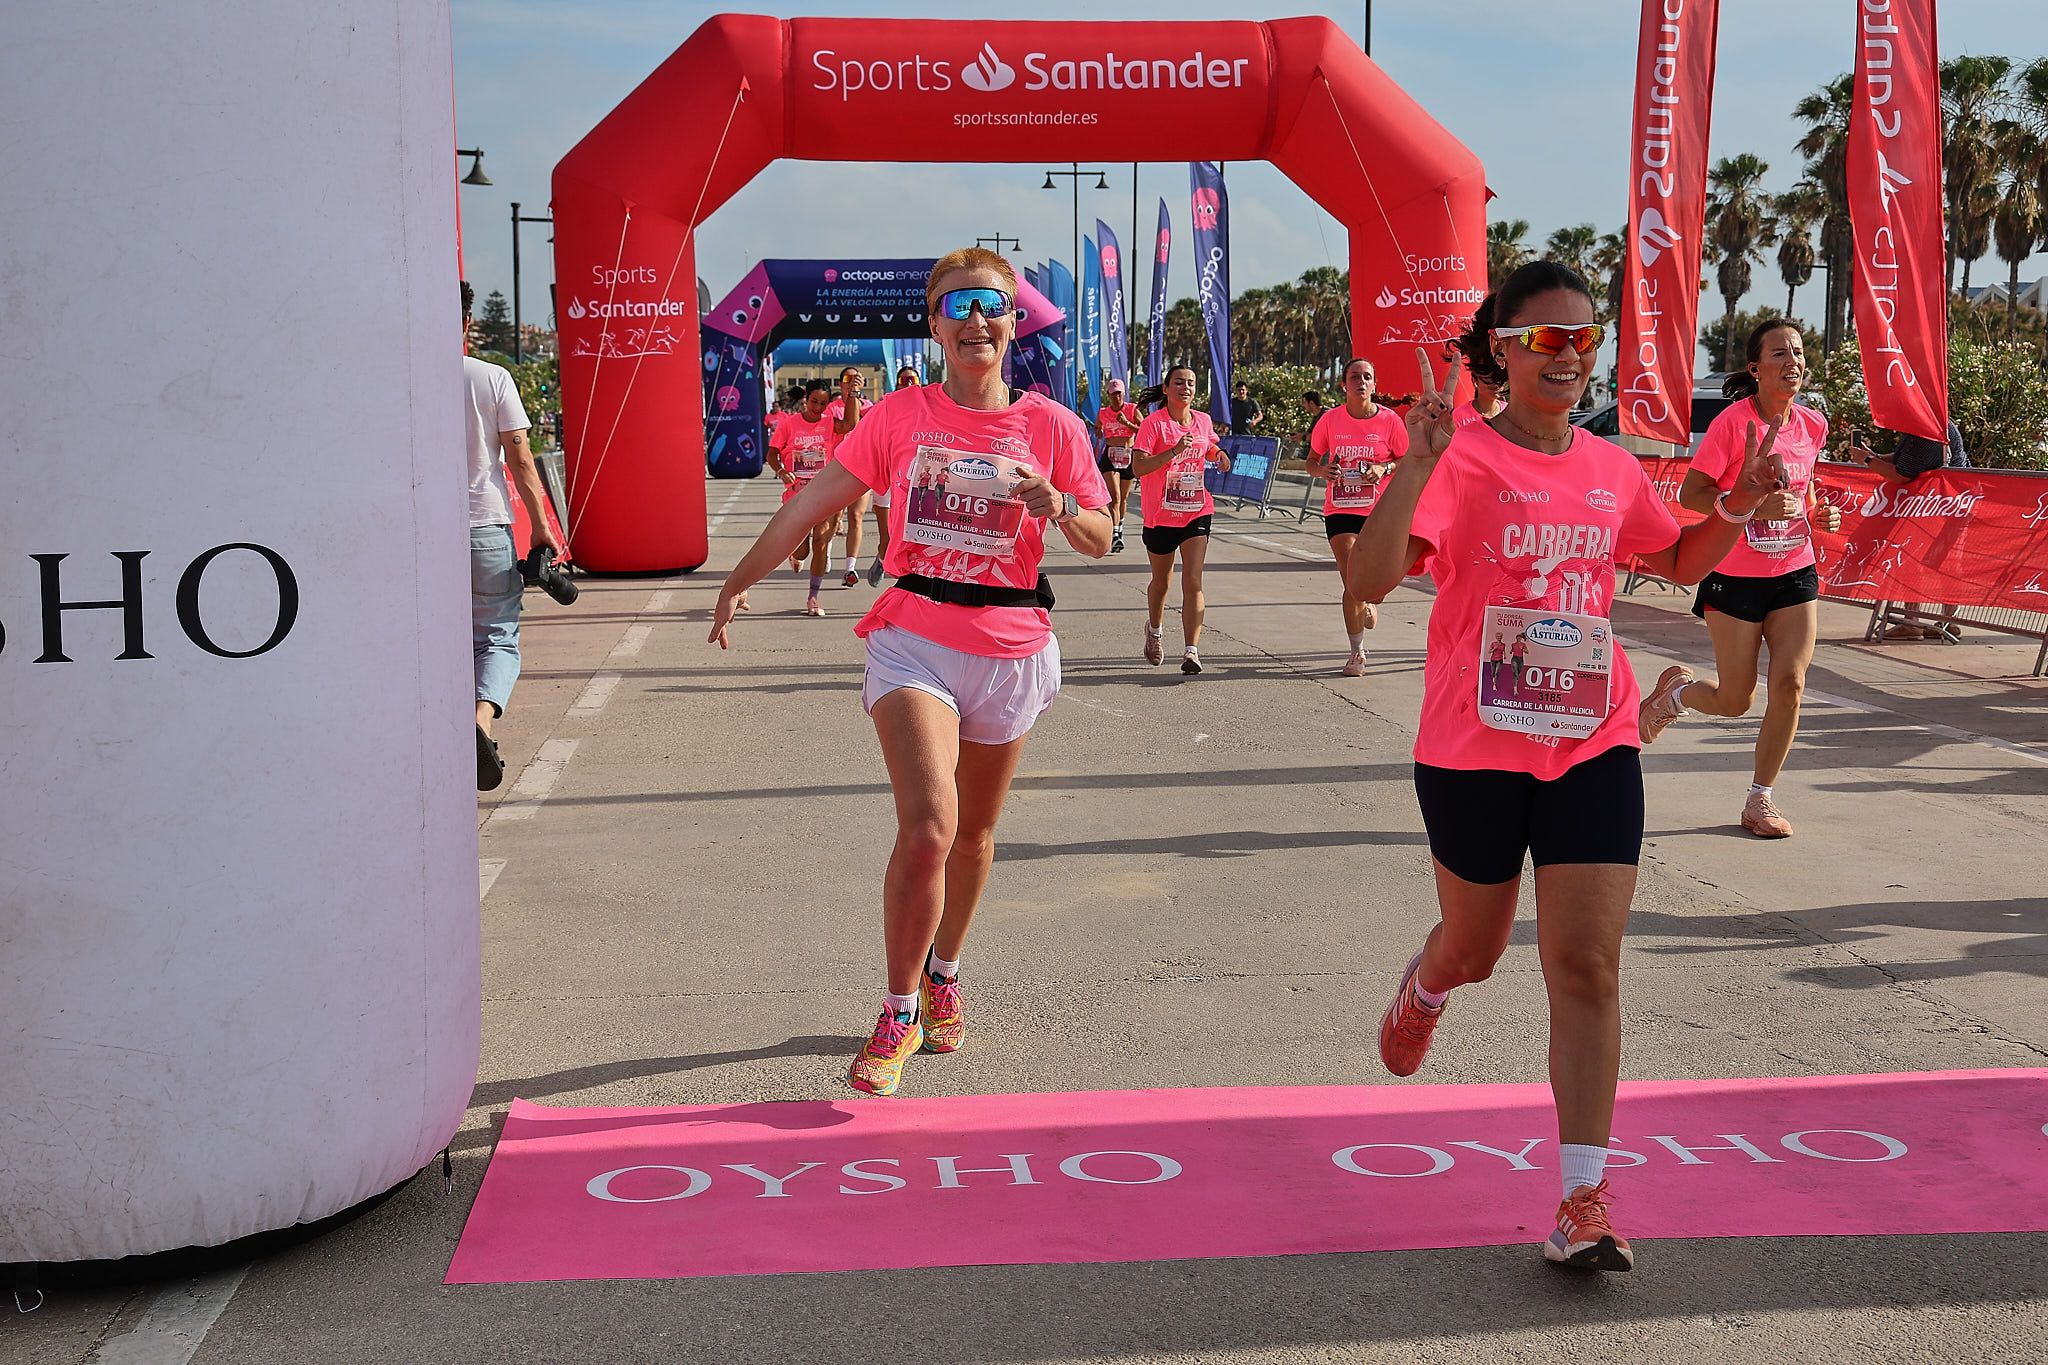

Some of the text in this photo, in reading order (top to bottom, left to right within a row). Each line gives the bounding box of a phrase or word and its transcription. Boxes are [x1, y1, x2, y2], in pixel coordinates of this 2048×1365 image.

[812, 49, 1248, 101] Sports Santander
[953, 111, 1098, 128] sportssantander.es
[1405, 254, 1466, 277] Sports
[592, 265, 657, 288] Sports
[842, 270, 895, 284] octopus
[817, 287, 926, 297] LA ENERGÍA PARA COR
[1400, 286, 1485, 305] Santander
[588, 298, 685, 318] Santander
[808, 338, 859, 361] Marlene
[911, 431, 955, 444] OYSHO
[1335, 446, 1375, 458] CARRERA
[952, 464, 995, 477] ASTURIANA
[1343, 485, 1361, 493] 016
[1499, 490, 1550, 503] OYSHO
[945, 493, 989, 515] 016
[917, 517, 943, 527] CARRERA
[959, 525, 979, 534] MUJER
[982, 528, 1008, 538] VALENCIA
[917, 529, 952, 542] OYSHO
[972, 541, 1004, 550] Santander
[1502, 523, 1611, 561] CARRERA
[0, 541, 299, 664] HO
[1496, 618, 1524, 628] SUMA
[1530, 627, 1579, 643] ASTURIANA
[1525, 667, 1575, 691] 016
[1538, 692, 1561, 703] 3185
[1492, 698, 1522, 709] CARRERA
[1523, 702, 1533, 710] DE
[1544, 704, 1566, 712] MUJER
[1569, 706, 1595, 716] VALENCIA
[1493, 712, 1535, 727] OYSHO
[1560, 721, 1594, 732] Santander
[1332, 1129, 1908, 1178] OYSHO
[586, 1150, 1183, 1204] OYSHO
